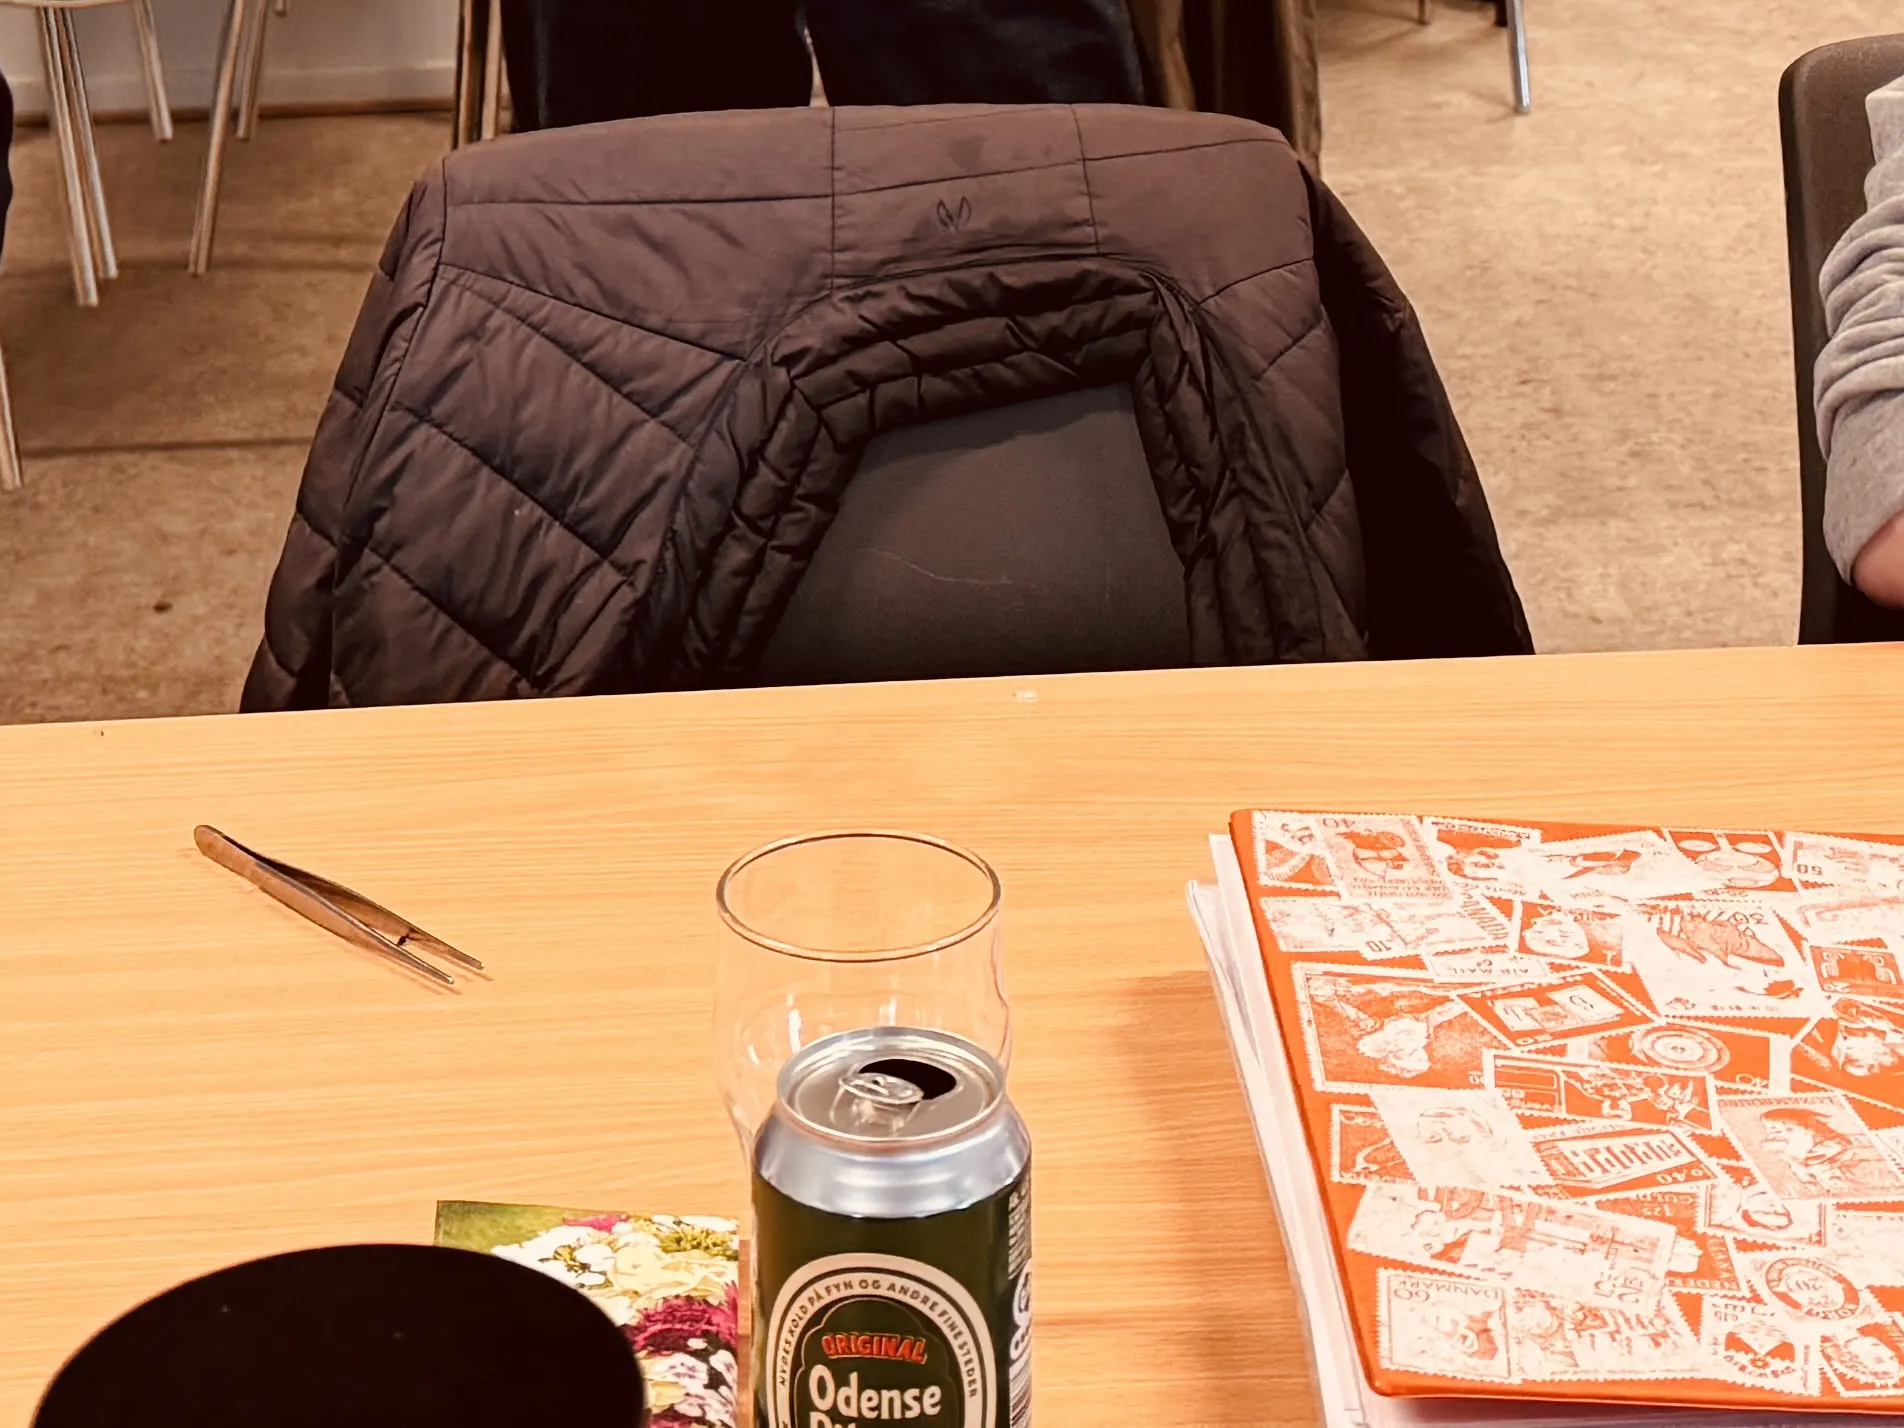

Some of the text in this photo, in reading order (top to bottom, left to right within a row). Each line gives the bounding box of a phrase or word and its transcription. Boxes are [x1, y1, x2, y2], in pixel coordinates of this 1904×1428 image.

[1397, 1279, 1499, 1300] DANMARK
[776, 1340, 793, 1387] NYDES
[789, 1304, 809, 1339] KOLD
[807, 1288, 825, 1308] PÅ
[824, 1280, 854, 1297] FYN
[858, 1278, 882, 1290] OG
[886, 1280, 938, 1313] ANDRE
[936, 1309, 965, 1343] FINE
[957, 1341, 978, 1398] STEDER
[820, 1333, 928, 1365] ORIGINAL
[808, 1364, 943, 1421] Odense
